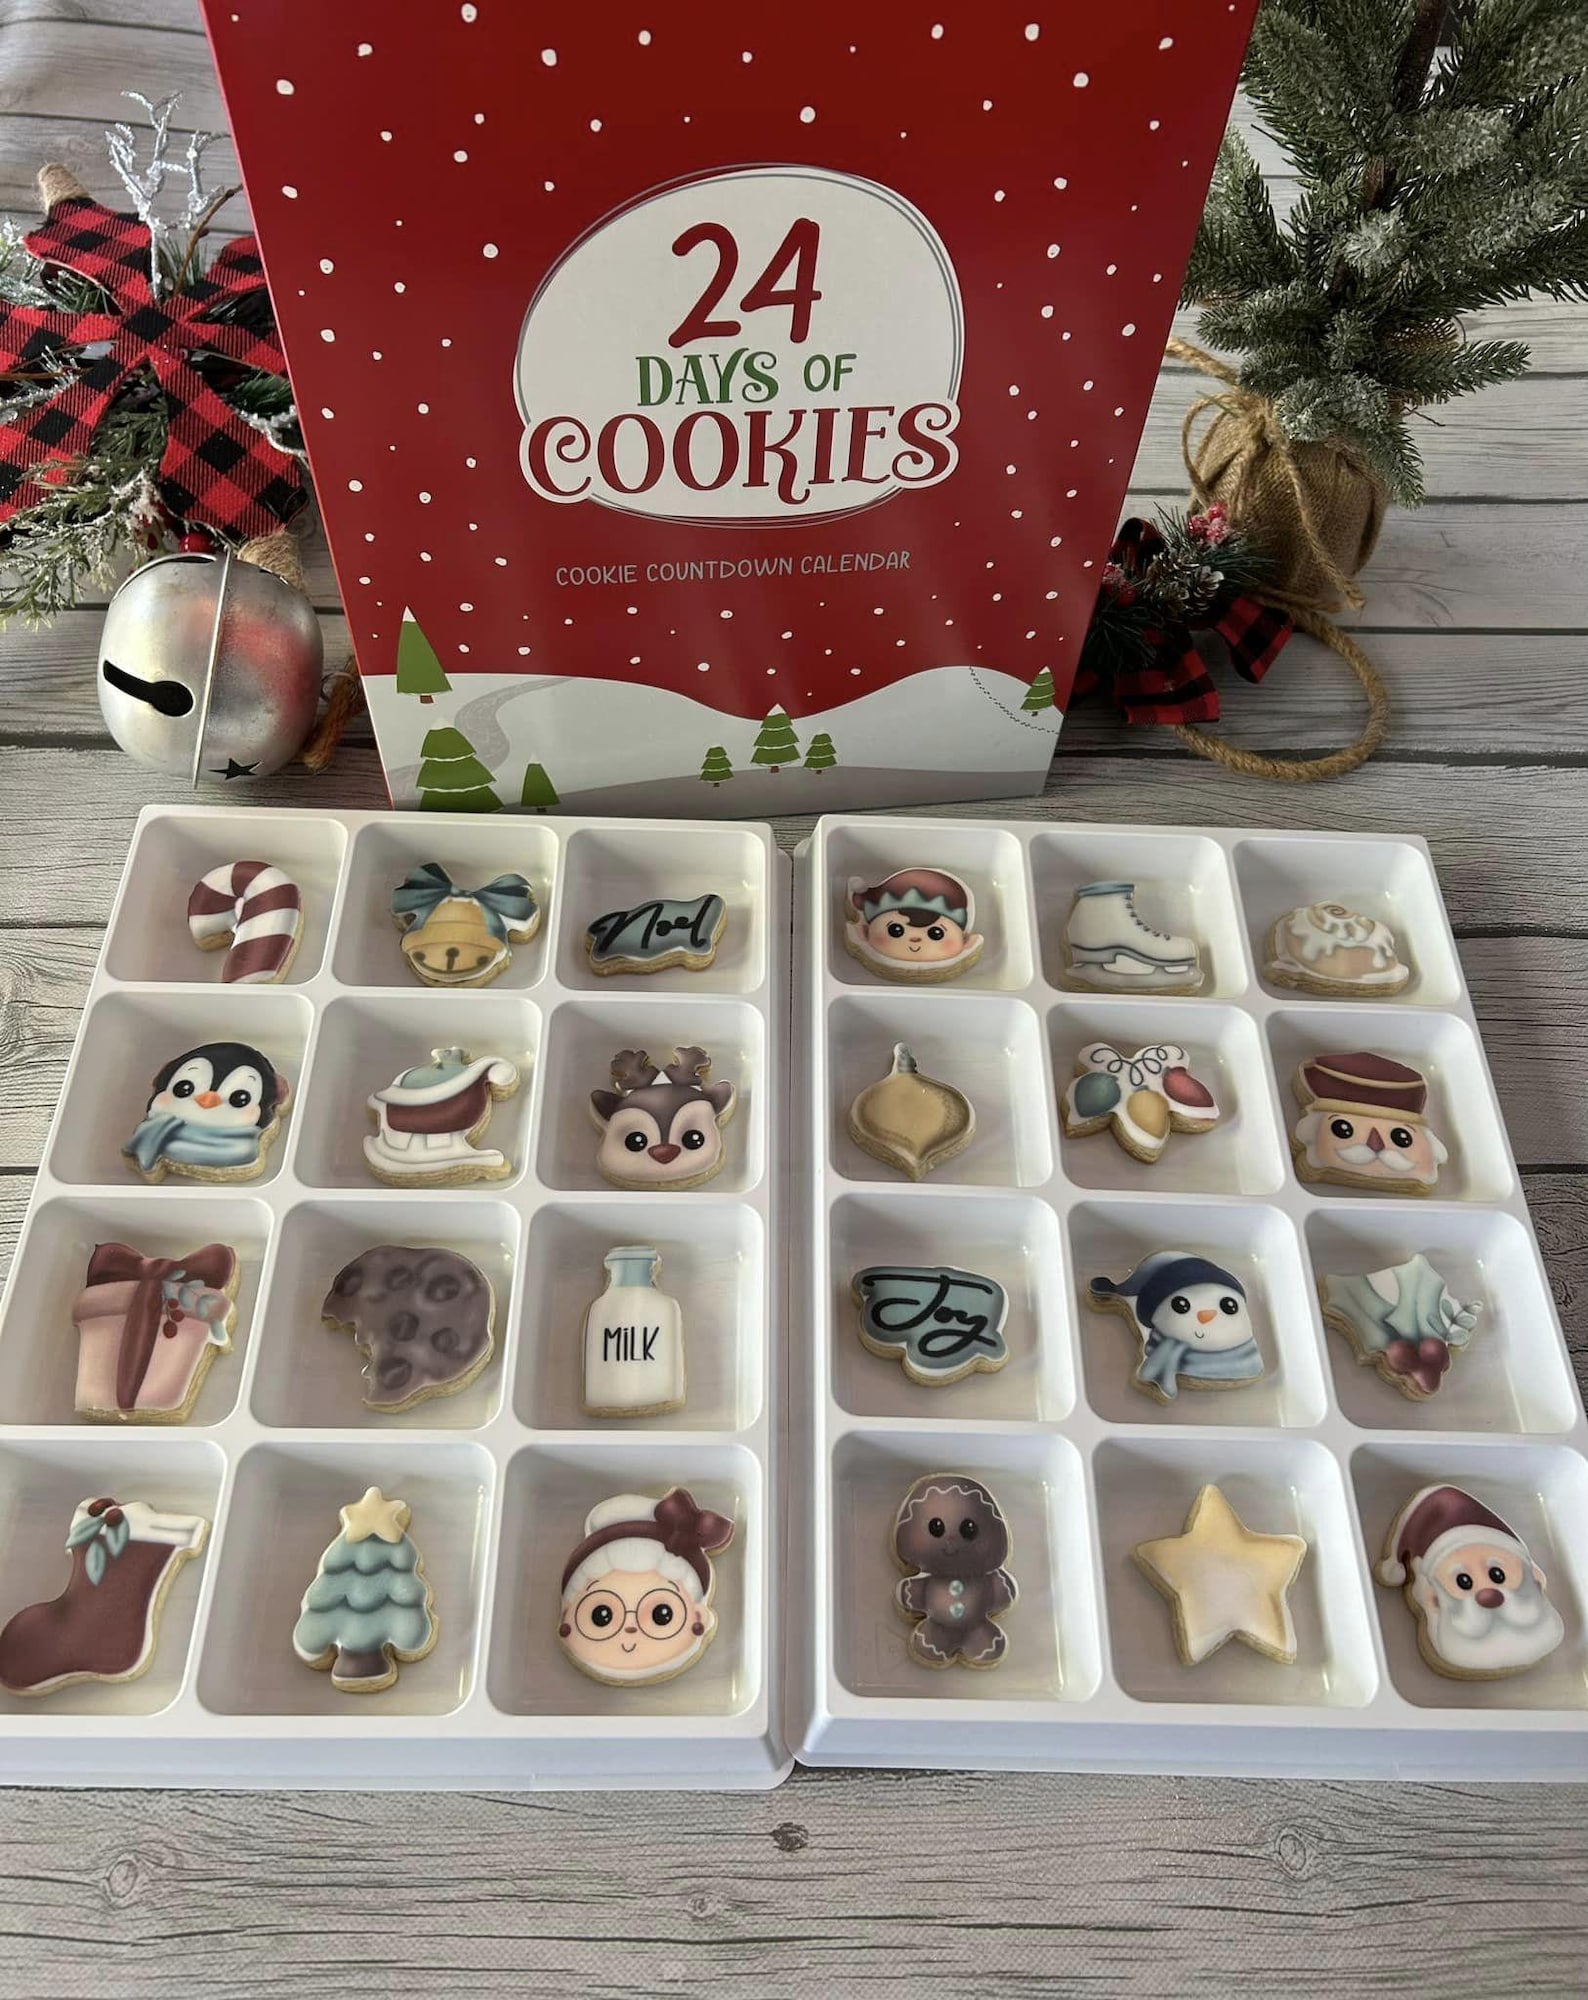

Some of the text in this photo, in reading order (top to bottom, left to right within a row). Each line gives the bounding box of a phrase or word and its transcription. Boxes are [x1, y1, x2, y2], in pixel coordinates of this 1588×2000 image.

[668, 217, 822, 348] 24
[636, 347, 857, 406] DAYS OF
[528, 403, 952, 505] COOKIES
[556, 551, 911, 586] COOKIE COUNTDOWN CALENDAR
[588, 894, 718, 953] Noel
[862, 1274, 997, 1358] Joy
